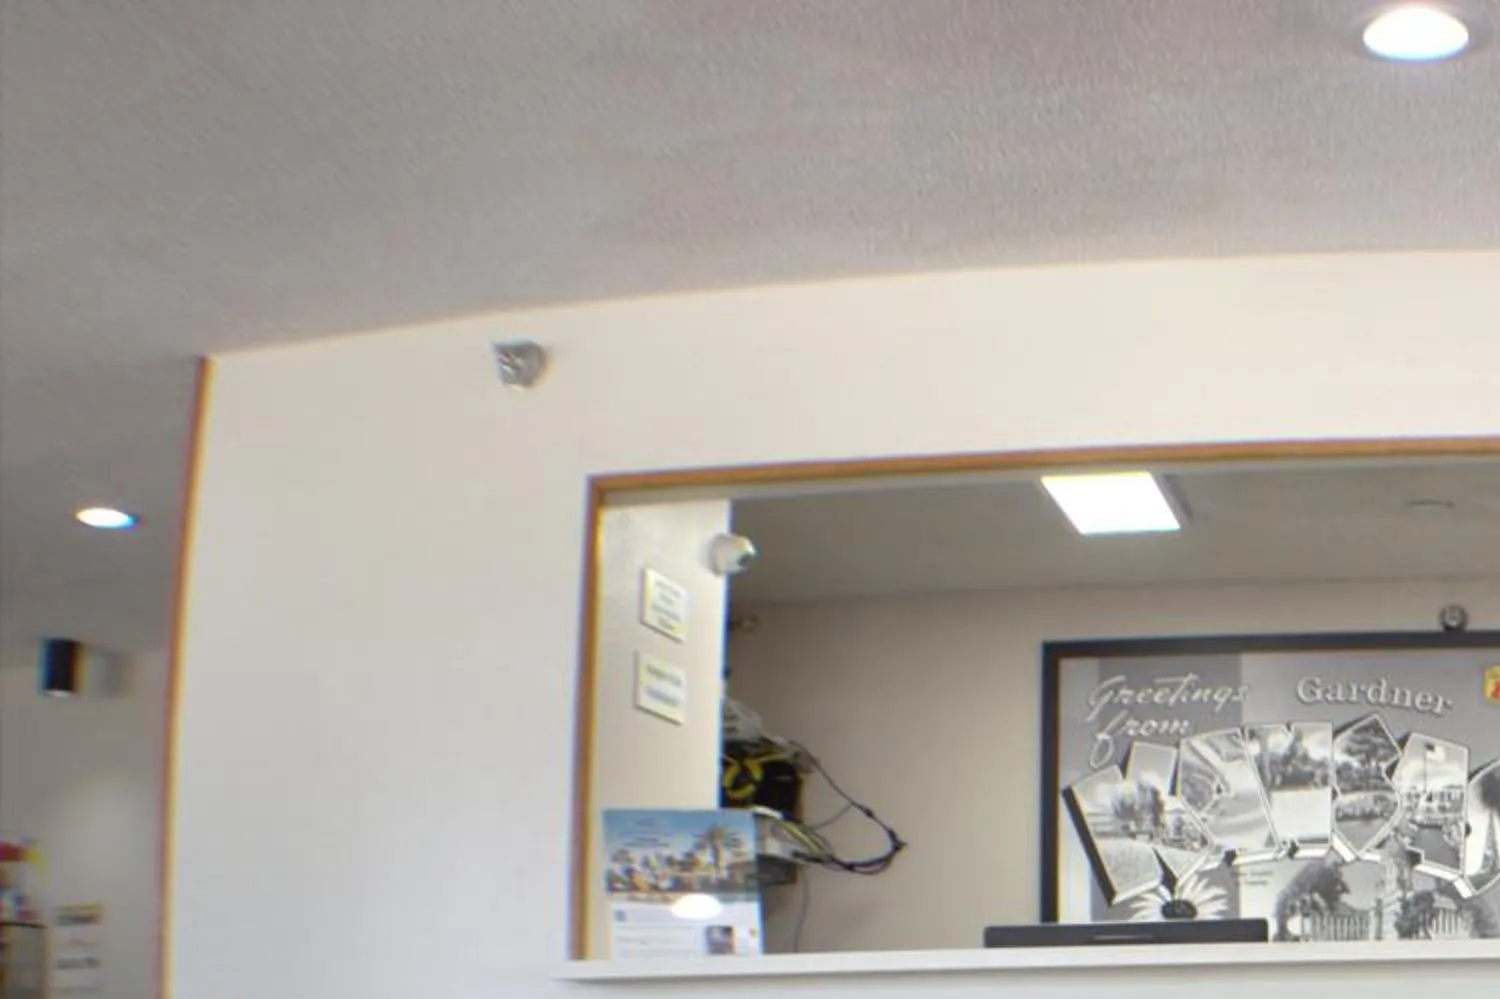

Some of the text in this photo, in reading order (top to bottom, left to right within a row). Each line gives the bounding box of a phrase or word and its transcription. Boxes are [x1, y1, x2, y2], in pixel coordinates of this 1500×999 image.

[1086, 671, 1248, 722] Greetings
[1297, 675, 1453, 714] Gardner
[1089, 709, 1190, 769] from
